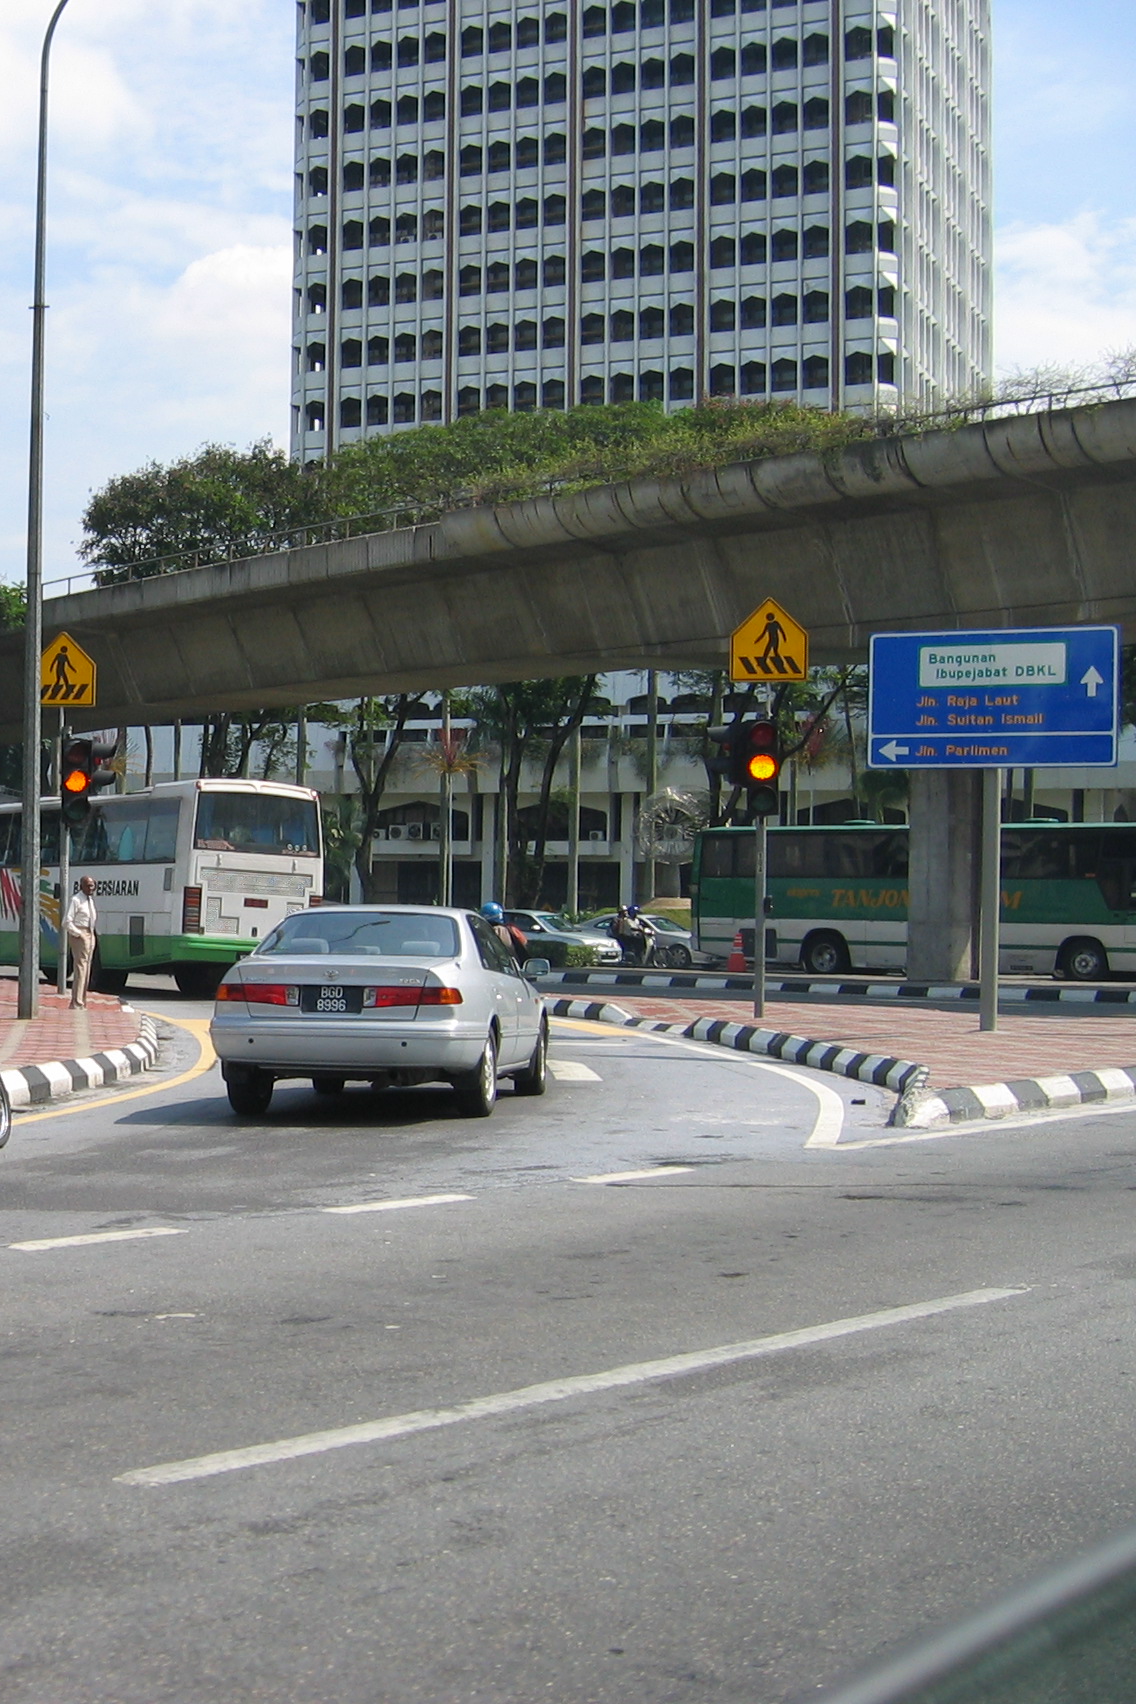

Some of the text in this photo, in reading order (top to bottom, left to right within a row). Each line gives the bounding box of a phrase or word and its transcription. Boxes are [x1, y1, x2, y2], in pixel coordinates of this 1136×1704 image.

[929, 653, 996, 666] Bangunan
[936, 665, 1056, 681] Ibupejabat DBKL
[916, 695, 1019, 709] Jln. Raja Laut
[915, 715, 939, 726] Jln.
[1001, 713, 1043, 724] Ismail
[915, 745, 1008, 757] Jln. Parlimen
[94, 880, 140, 896] ERSIARAN
[830, 889, 911, 908] TANJON
[321, 986, 343, 998] BGD
[317, 999, 346, 1011] 8996
